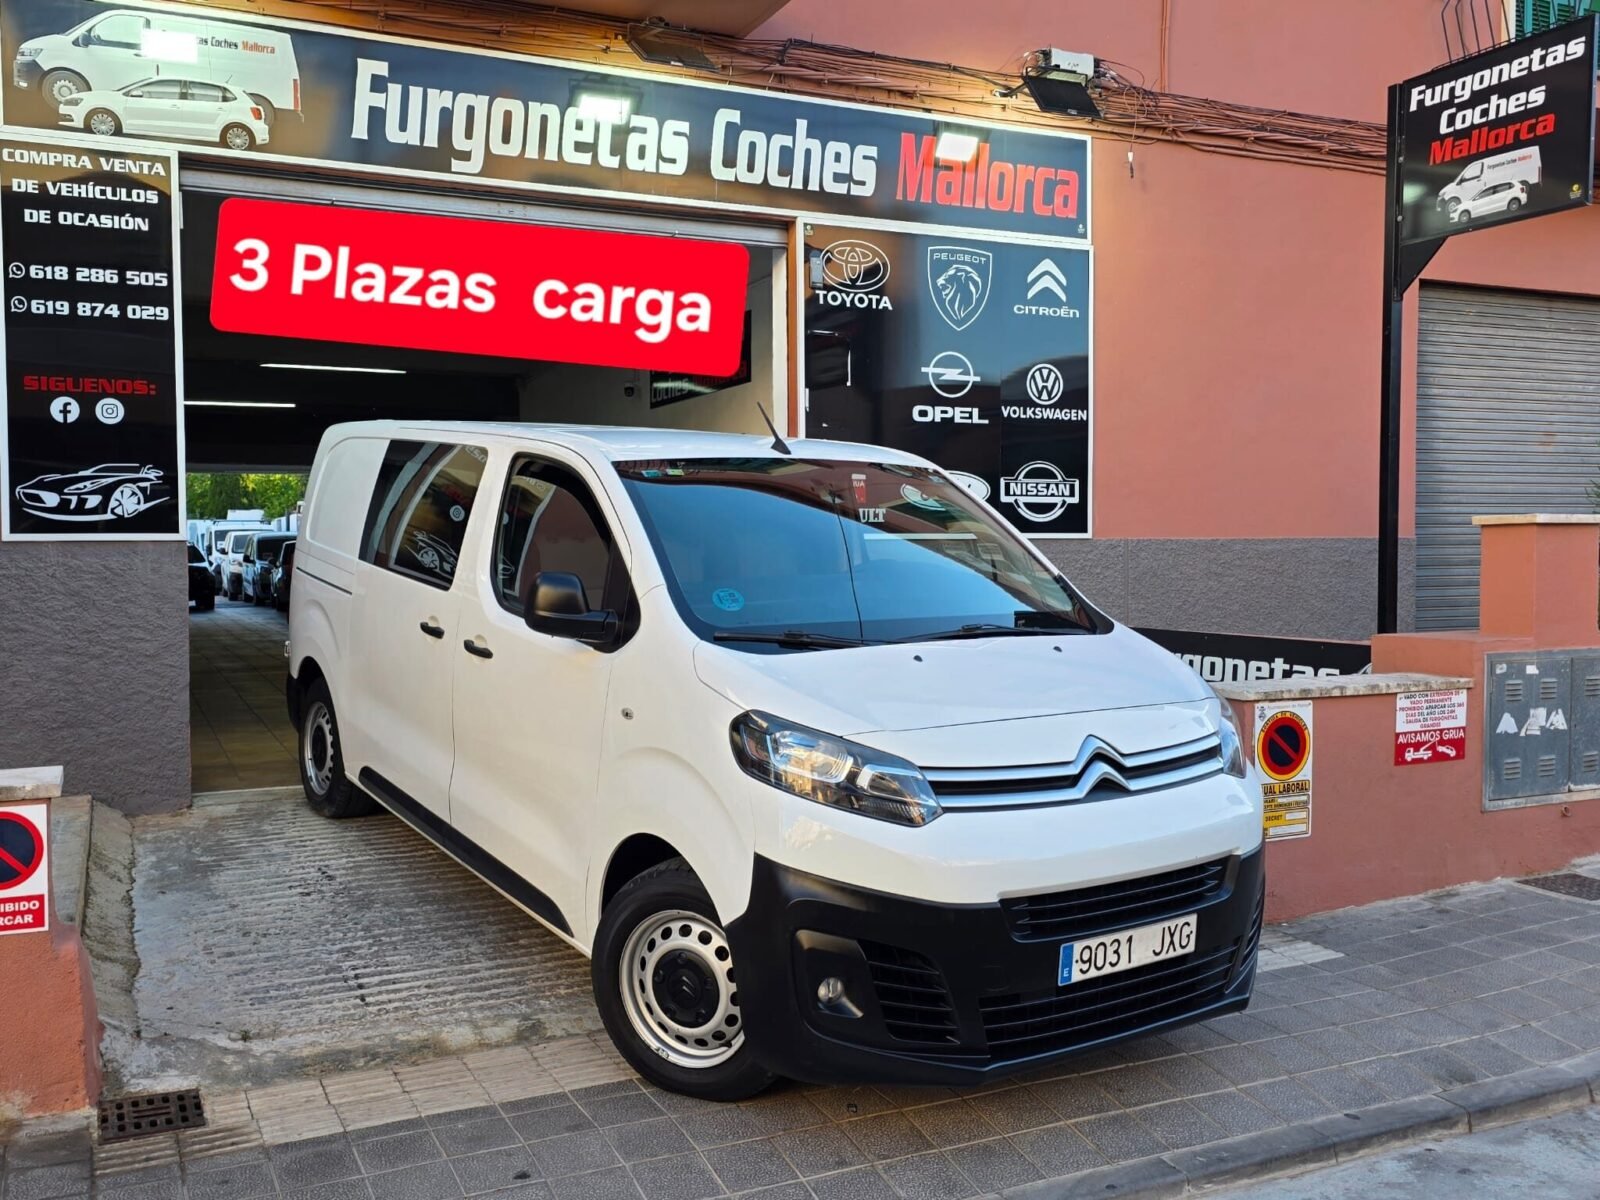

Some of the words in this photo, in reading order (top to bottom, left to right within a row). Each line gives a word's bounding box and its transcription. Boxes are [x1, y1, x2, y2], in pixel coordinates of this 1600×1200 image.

[242, 40, 275, 54] Mallorca
[1409, 36, 1586, 112] Furgonetas
[1439, 85, 1546, 135] Coches
[351, 57, 689, 175] Furgonetas
[710, 108, 878, 197] Coches
[896, 131, 1080, 219] Mallorca
[1429, 112, 1556, 166] Mallorca
[2, 148, 94, 169] COMPRA
[99, 157, 166, 176] VENTA
[12, 178, 39, 194] DE
[46, 181, 159, 204] VEHÍCULOS
[24, 208, 51, 224] DE
[58, 211, 149, 231] OCASIÓN
[933, 252, 987, 265] PEUGEOT
[29, 265, 69, 280] 618
[76, 267, 119, 283] 286
[126, 271, 168, 287] 505
[31, 299, 70, 315] 619
[77, 302, 120, 318] 874
[127, 305, 169, 321] 029
[815, 290, 893, 310] TOYOTA
[24, 375, 156, 396] SIGUENOS:
[912, 405, 989, 424] OPEL
[1001, 405, 1088, 421] VOLKSWAGEN
[1010, 482, 1070, 497] NISSAN
[1397, 731, 1441, 744] AVISAMOS
[1442, 728, 1465, 740] GRUA
[1262, 784, 1276, 795] UAL
[1279, 781, 1308, 793] LABORAL
[0, 900, 40, 913] IBIDO
[1063, 967, 1070, 977] E
[1079, 935, 1133, 974] 9031
[1152, 921, 1192, 956] JXG
